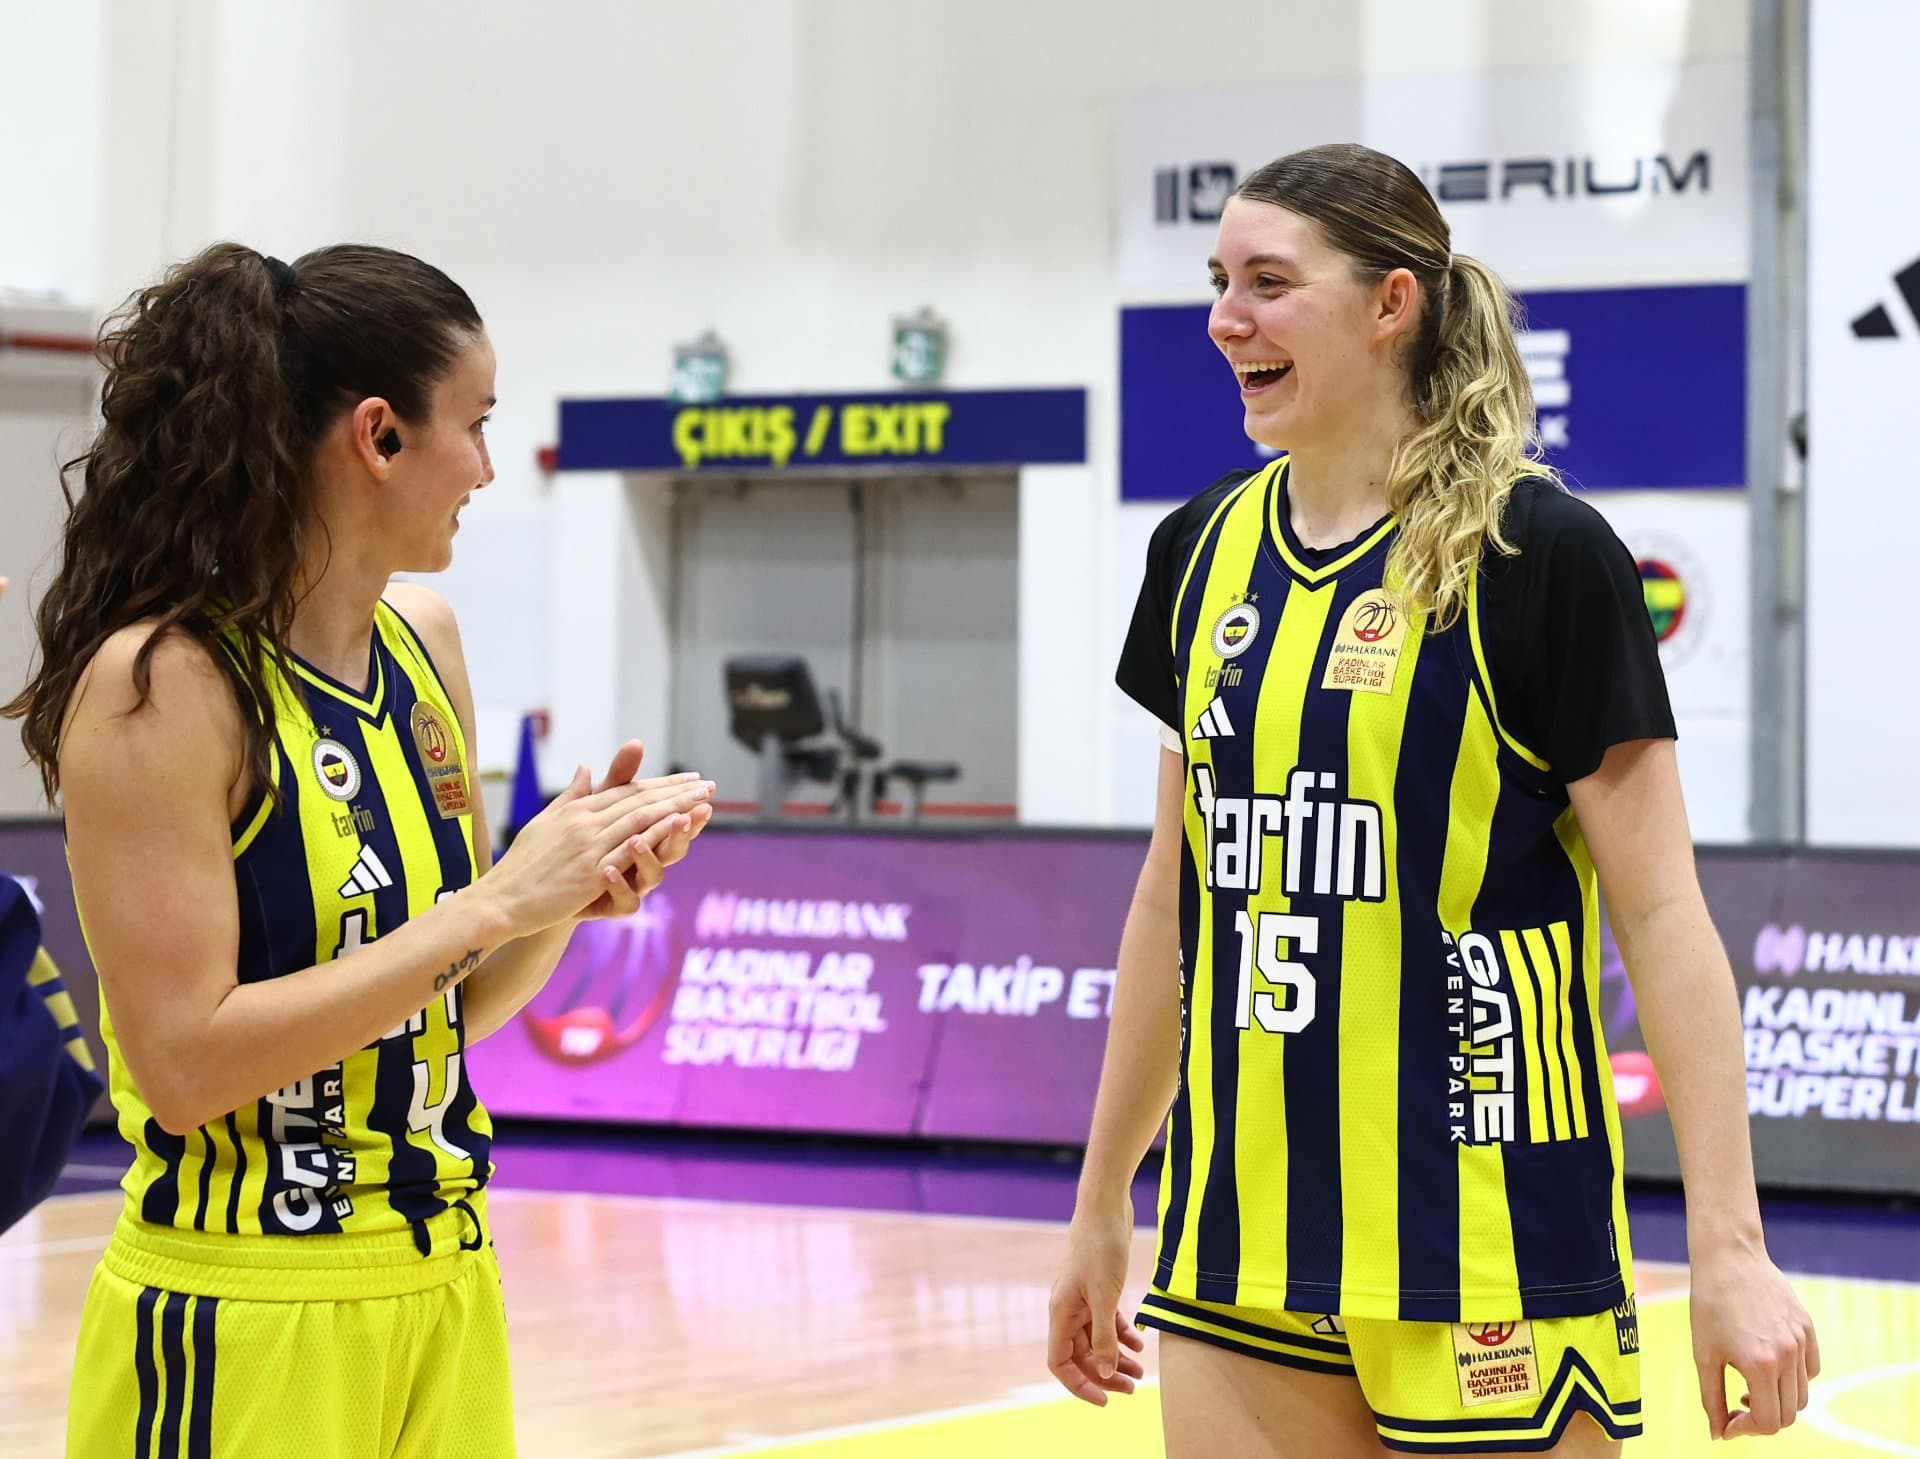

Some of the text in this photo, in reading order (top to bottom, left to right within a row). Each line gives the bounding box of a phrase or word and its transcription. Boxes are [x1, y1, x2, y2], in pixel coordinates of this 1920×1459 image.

[1421, 149, 1710, 202] ERIUM
[672, 402, 950, 469] ÇIKIŞ / EXIT
[1204, 663, 1243, 688] tarfin
[1332, 667, 1387, 679] BASKETBOL
[1345, 644, 1398, 657] HALKBANK
[331, 804, 375, 838] tarfin
[1195, 767, 1382, 898] tarfin
[917, 954, 1064, 1016] TAKİP
[1234, 910, 1319, 1034] 15
[1441, 931, 1467, 1142] EVENT PARK
[1458, 932, 1515, 1142] GATE
[1743, 1029, 1920, 1076] BASKET
[324, 1061, 344, 1137] PAR
[1469, 1363, 1526, 1379] KADINLAR
[1471, 1345, 1532, 1363] HALKBANK
[1467, 1372, 1531, 1389] BASKETBOL
